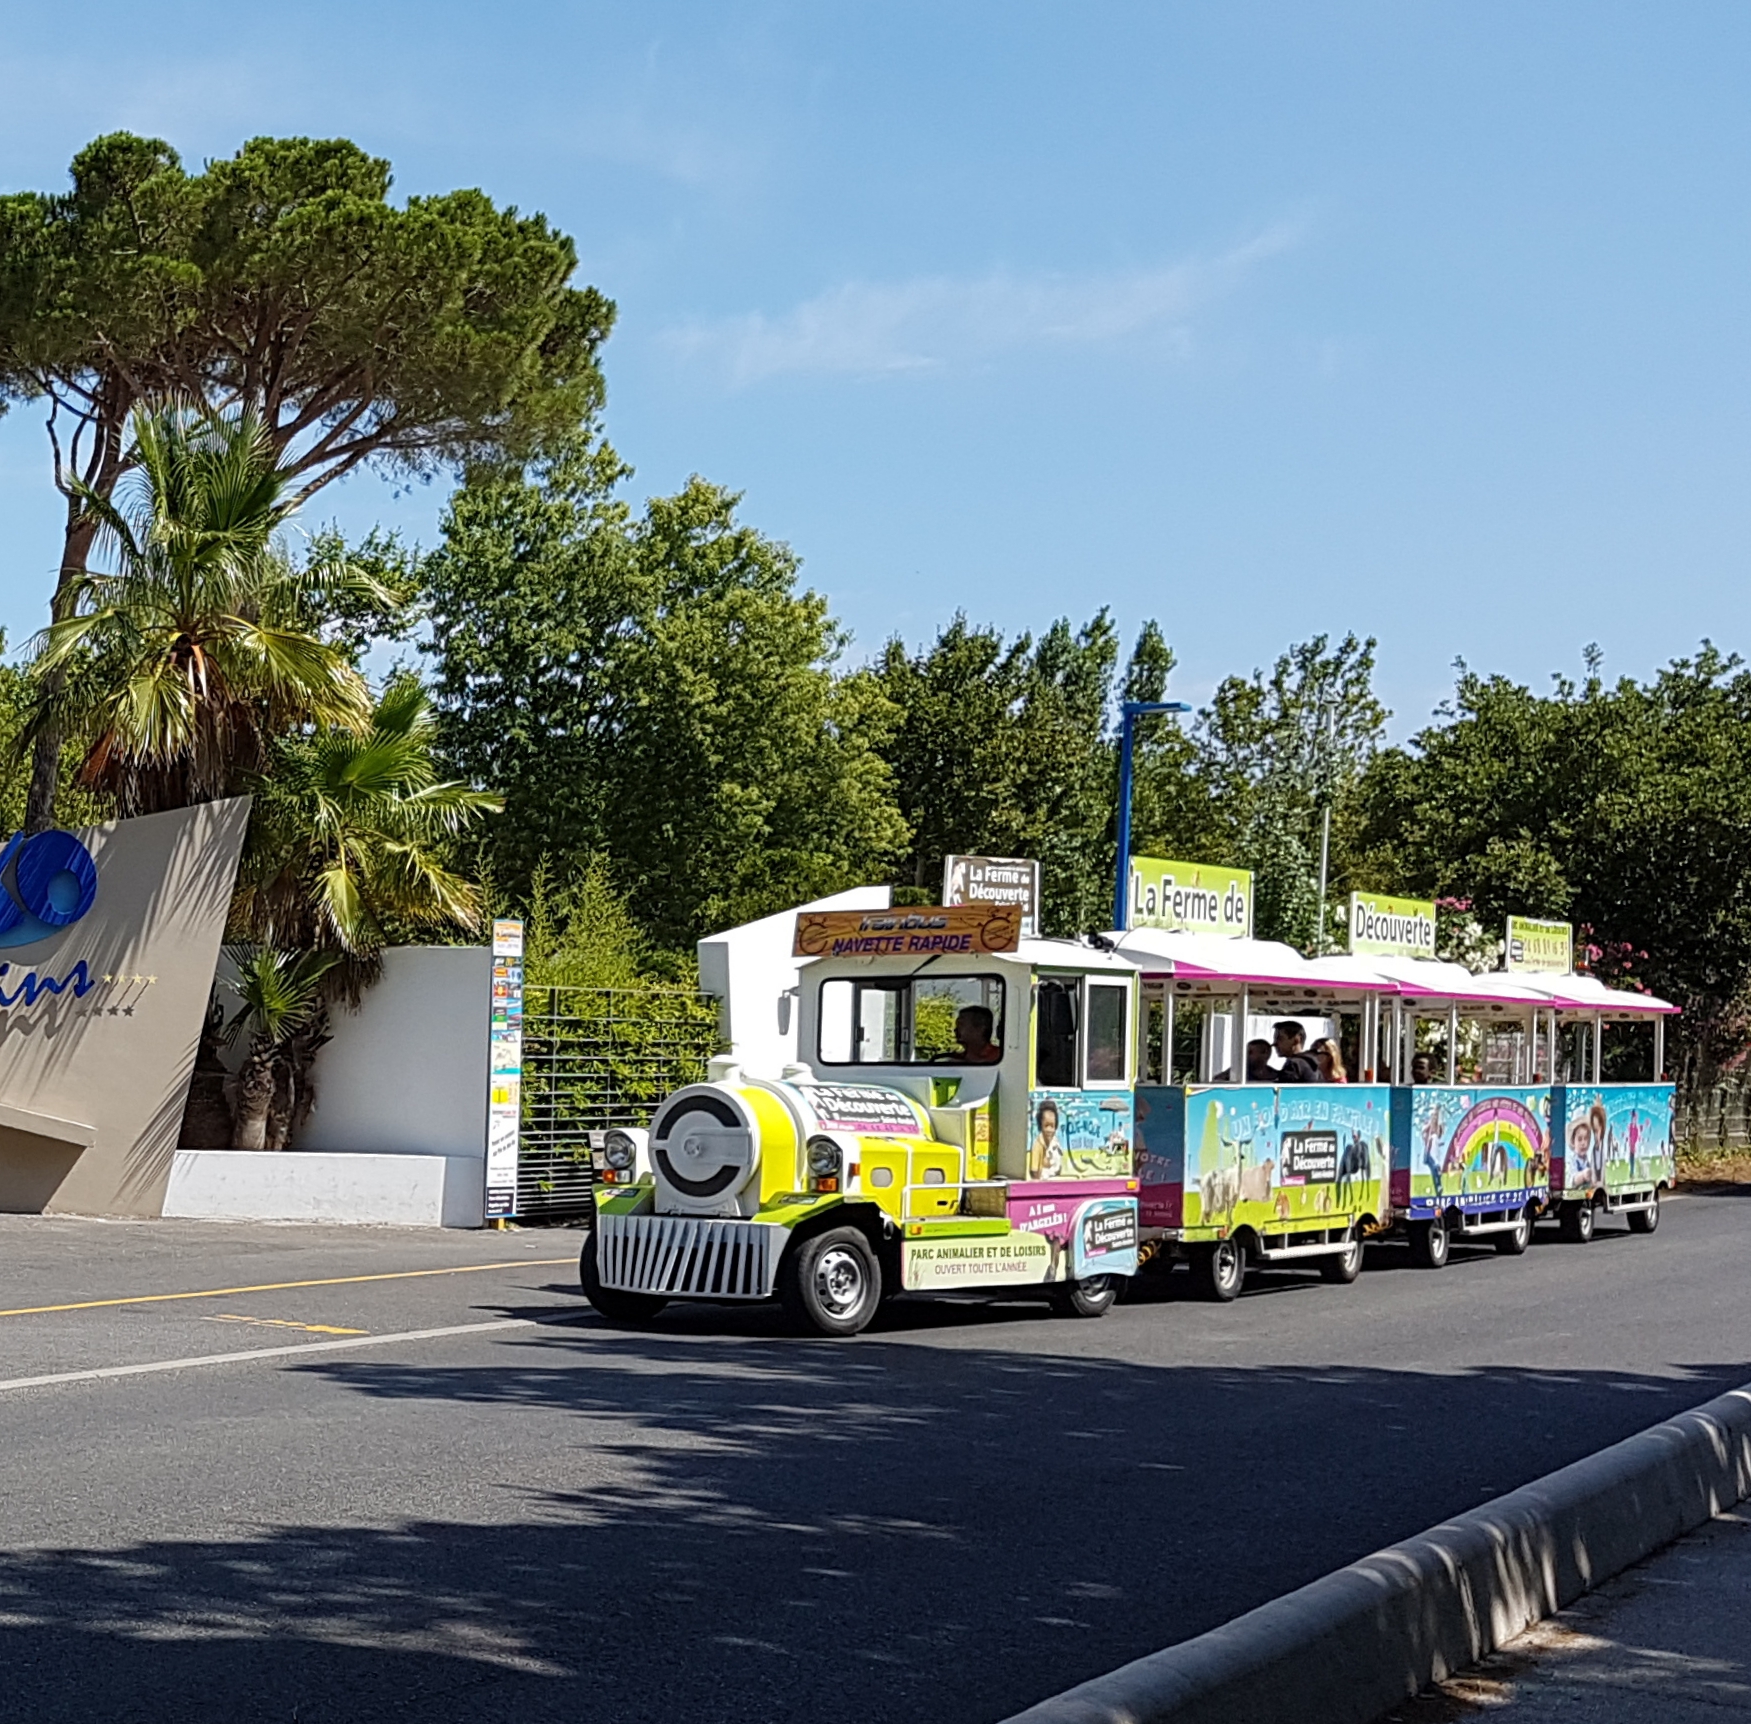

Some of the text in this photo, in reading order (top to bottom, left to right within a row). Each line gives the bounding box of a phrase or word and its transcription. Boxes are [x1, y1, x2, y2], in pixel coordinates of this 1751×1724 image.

[969, 864, 983, 882] La
[984, 865, 1019, 884] Ferme
[969, 882, 1030, 902] Découverte
[1134, 875, 1244, 923] La Ferme de
[1355, 902, 1432, 947] Découverte
[832, 933, 973, 955] NAVETTE RAPIDE
[825, 1096, 912, 1117] Découverte
[1232, 1115, 1250, 1140] UN
[1294, 1138, 1303, 1154] La
[1304, 1138, 1328, 1154] Ferme
[1094, 1220, 1103, 1232] La
[1104, 1217, 1126, 1231] Ferme
[911, 1244, 1046, 1261] PARC ANIMALIER ET DE LOISIRS
[934, 1259, 1028, 1276] OUVERT TOUTE L'ANNÉE
